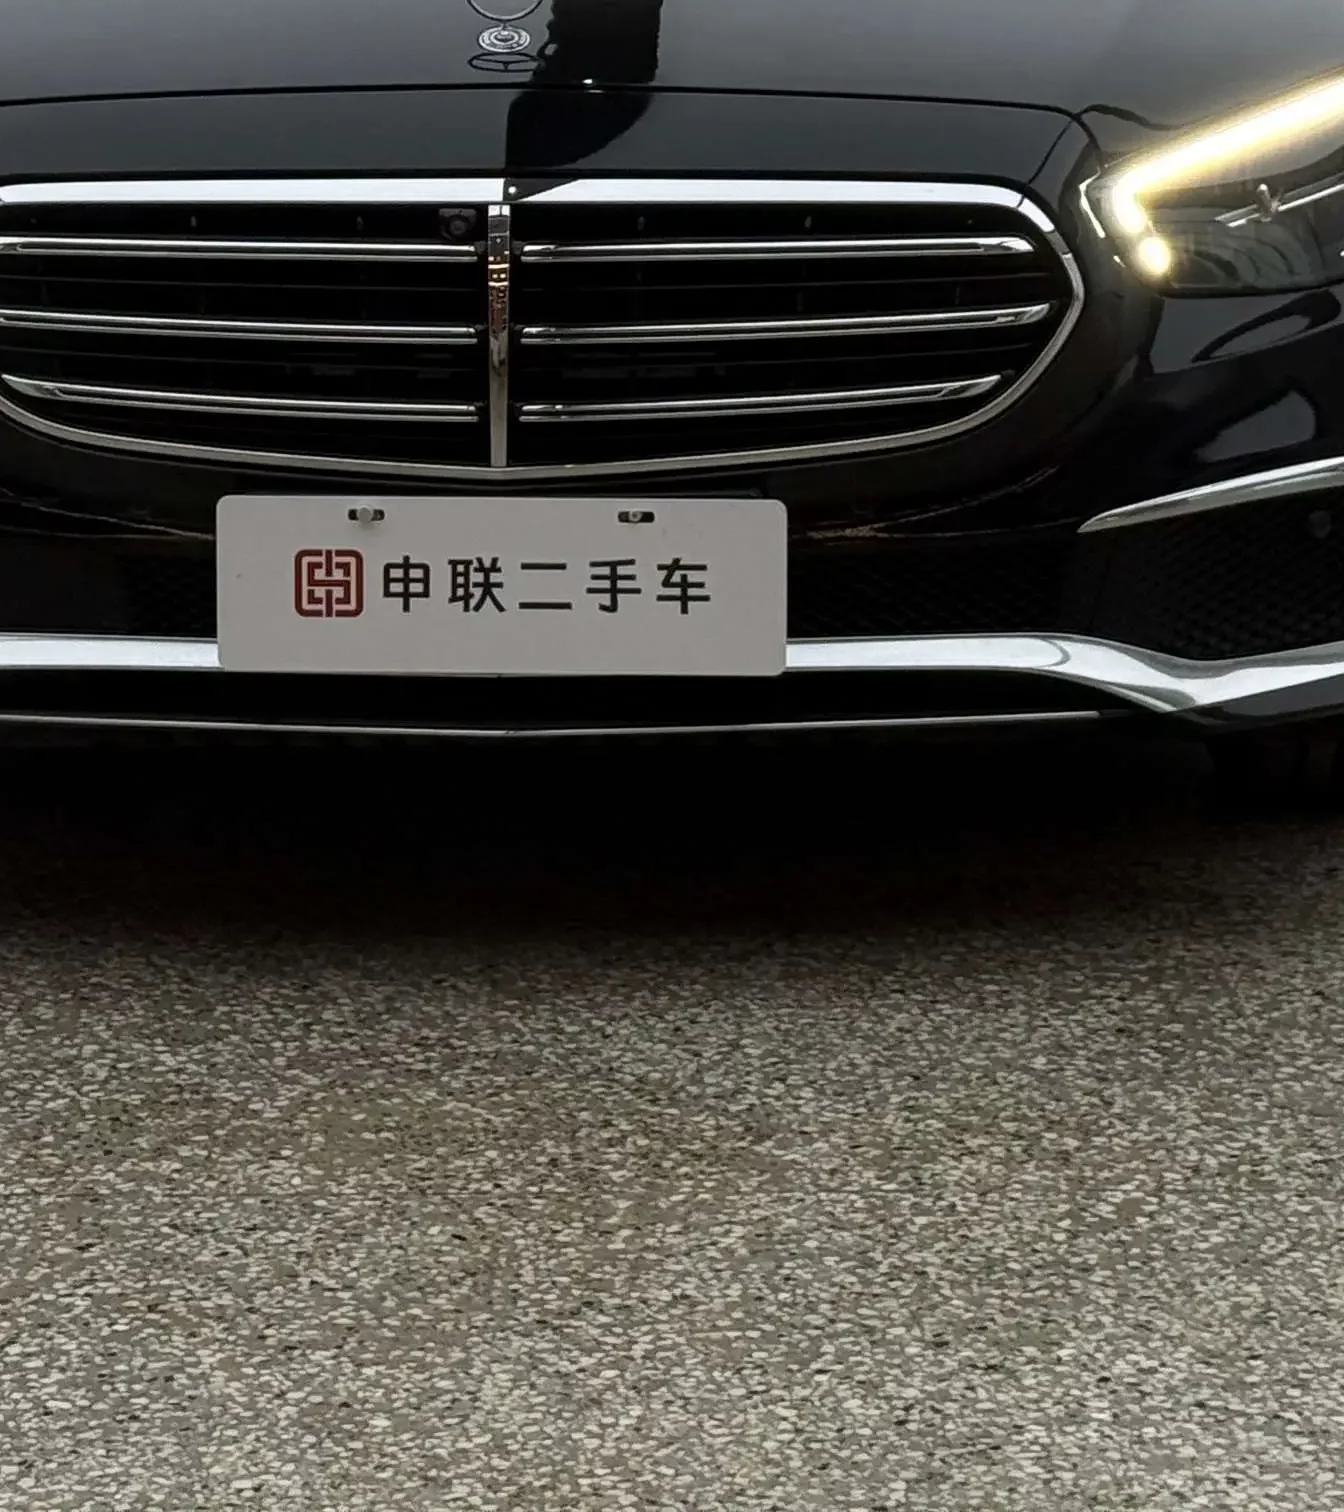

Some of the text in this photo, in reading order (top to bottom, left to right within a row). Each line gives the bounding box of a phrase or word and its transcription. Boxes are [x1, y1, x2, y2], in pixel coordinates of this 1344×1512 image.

[381, 553, 712, 616] 申联二手车
